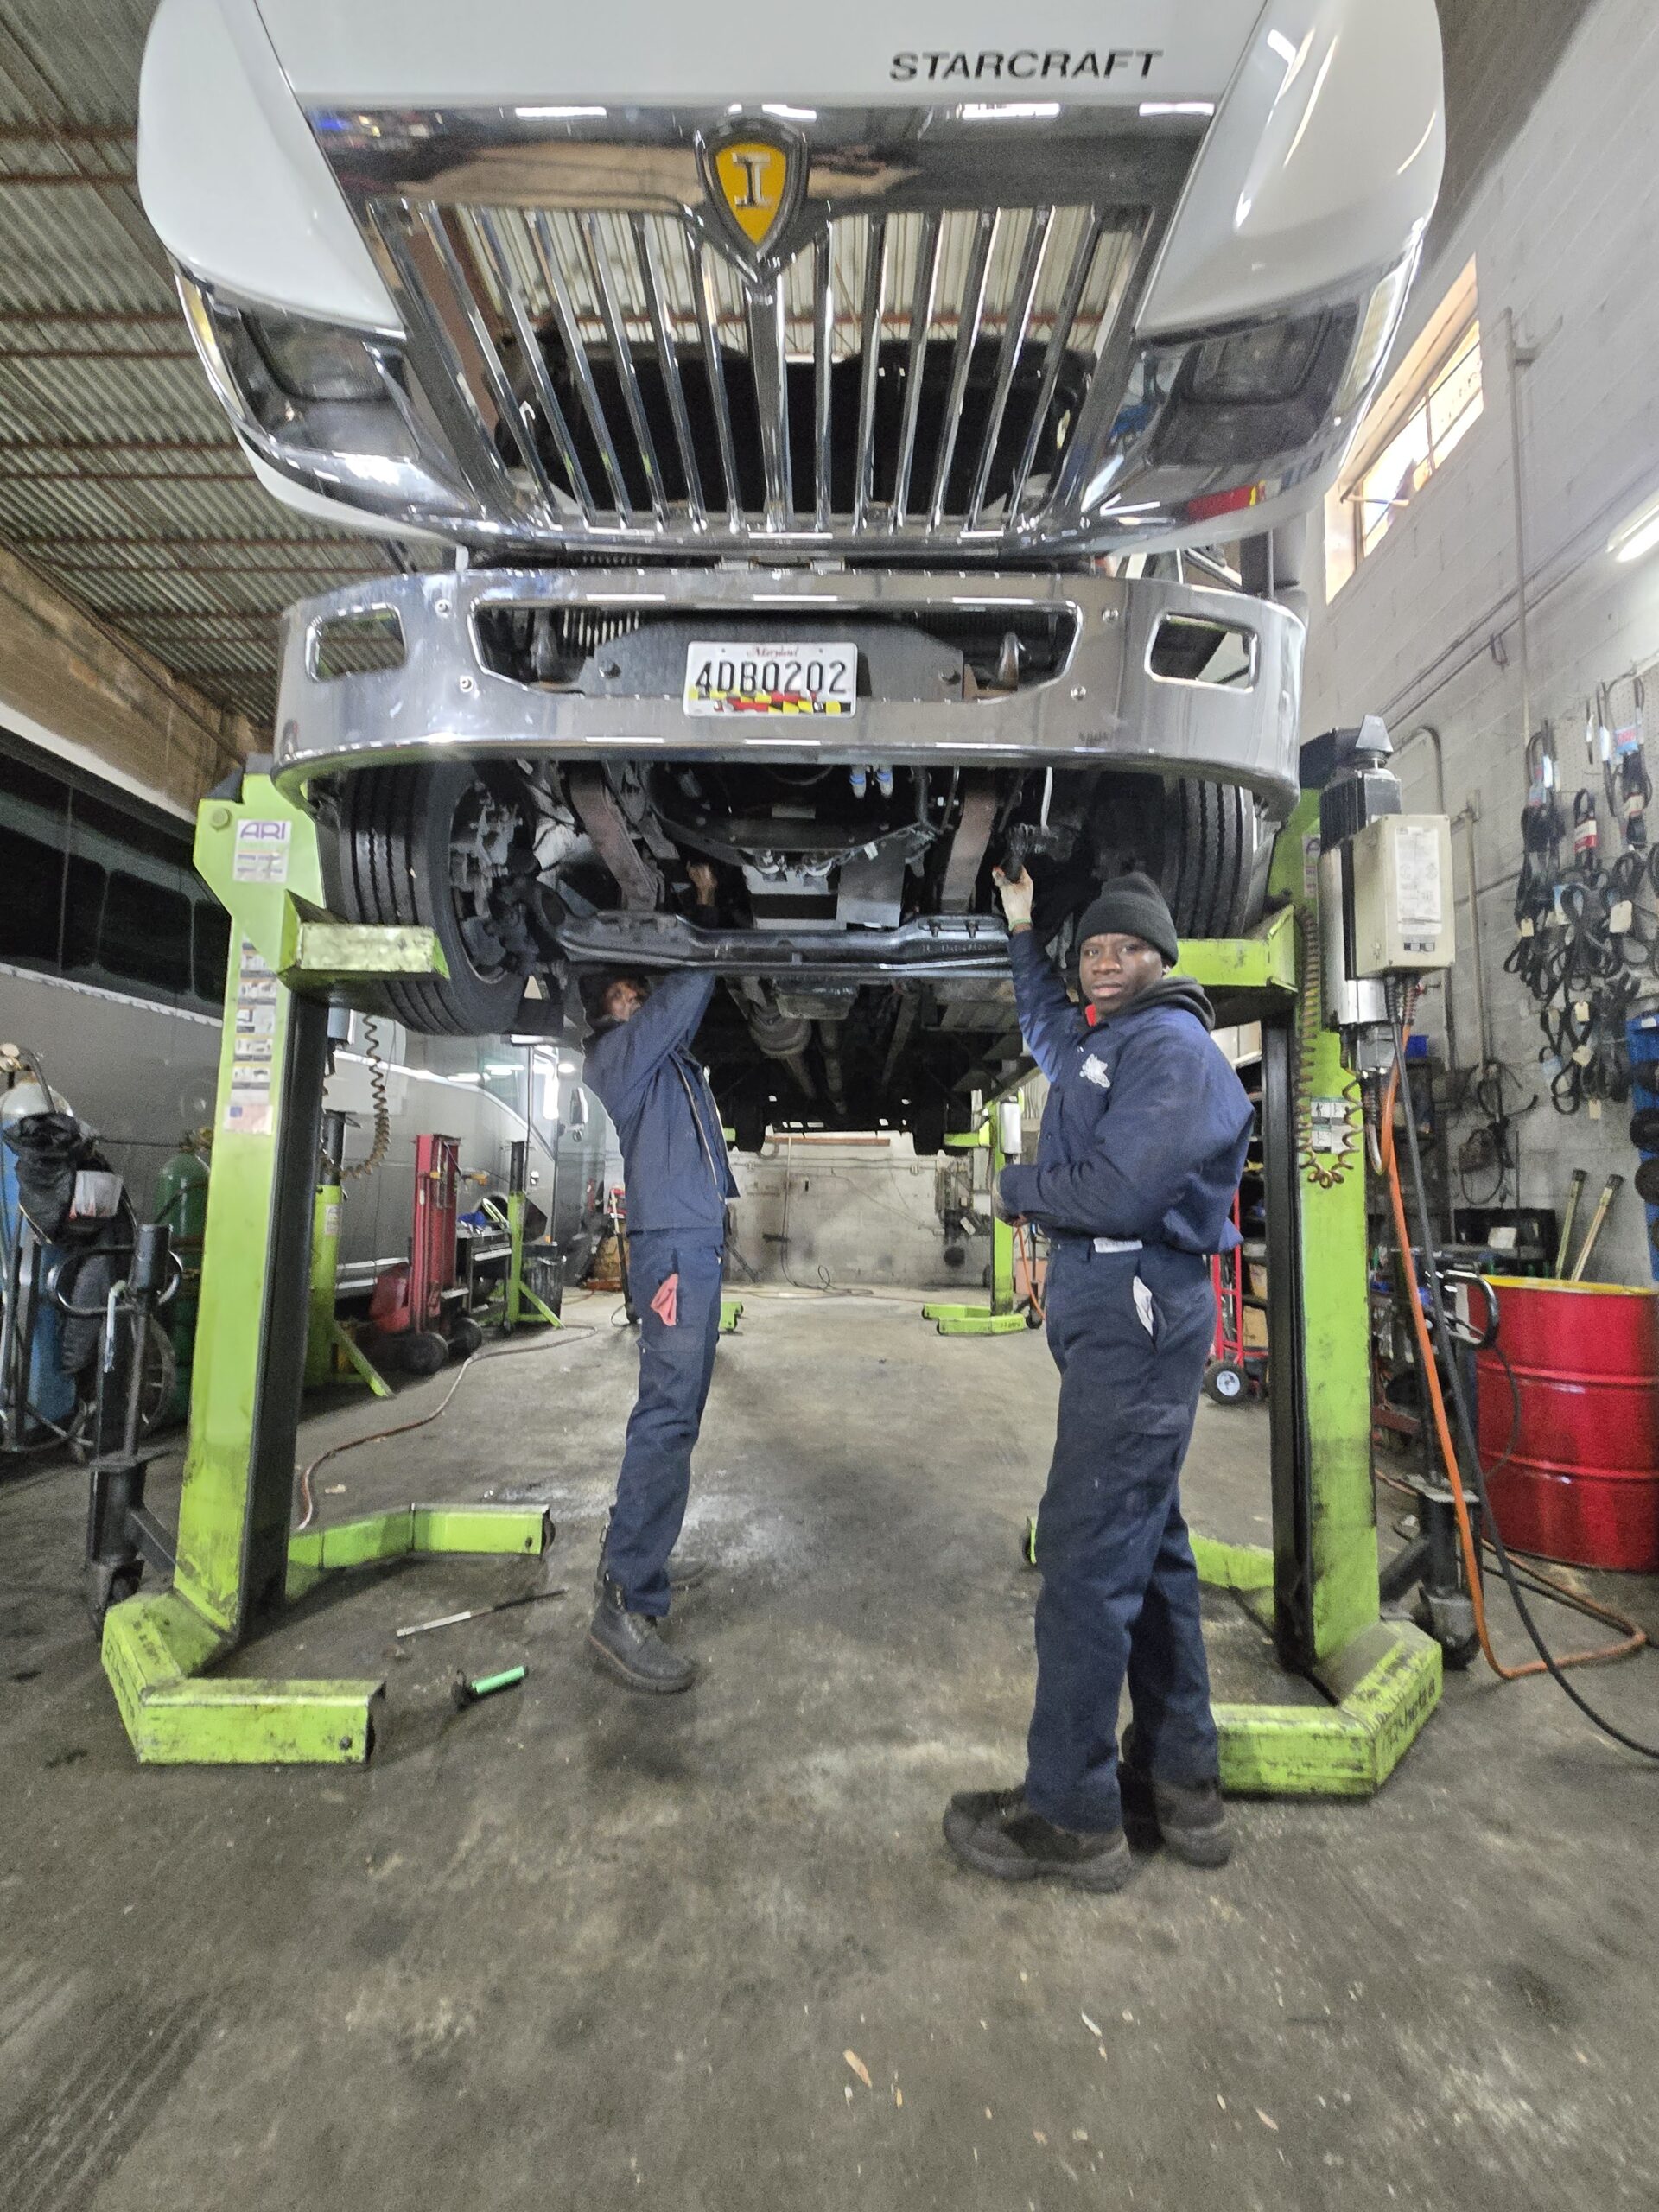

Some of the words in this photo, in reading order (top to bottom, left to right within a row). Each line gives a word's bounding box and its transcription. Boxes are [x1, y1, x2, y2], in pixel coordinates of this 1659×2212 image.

[889, 49, 1164, 81] STARCRAFT
[695, 660, 847, 696] 4DB0202
[240, 822, 286, 840] ARI
